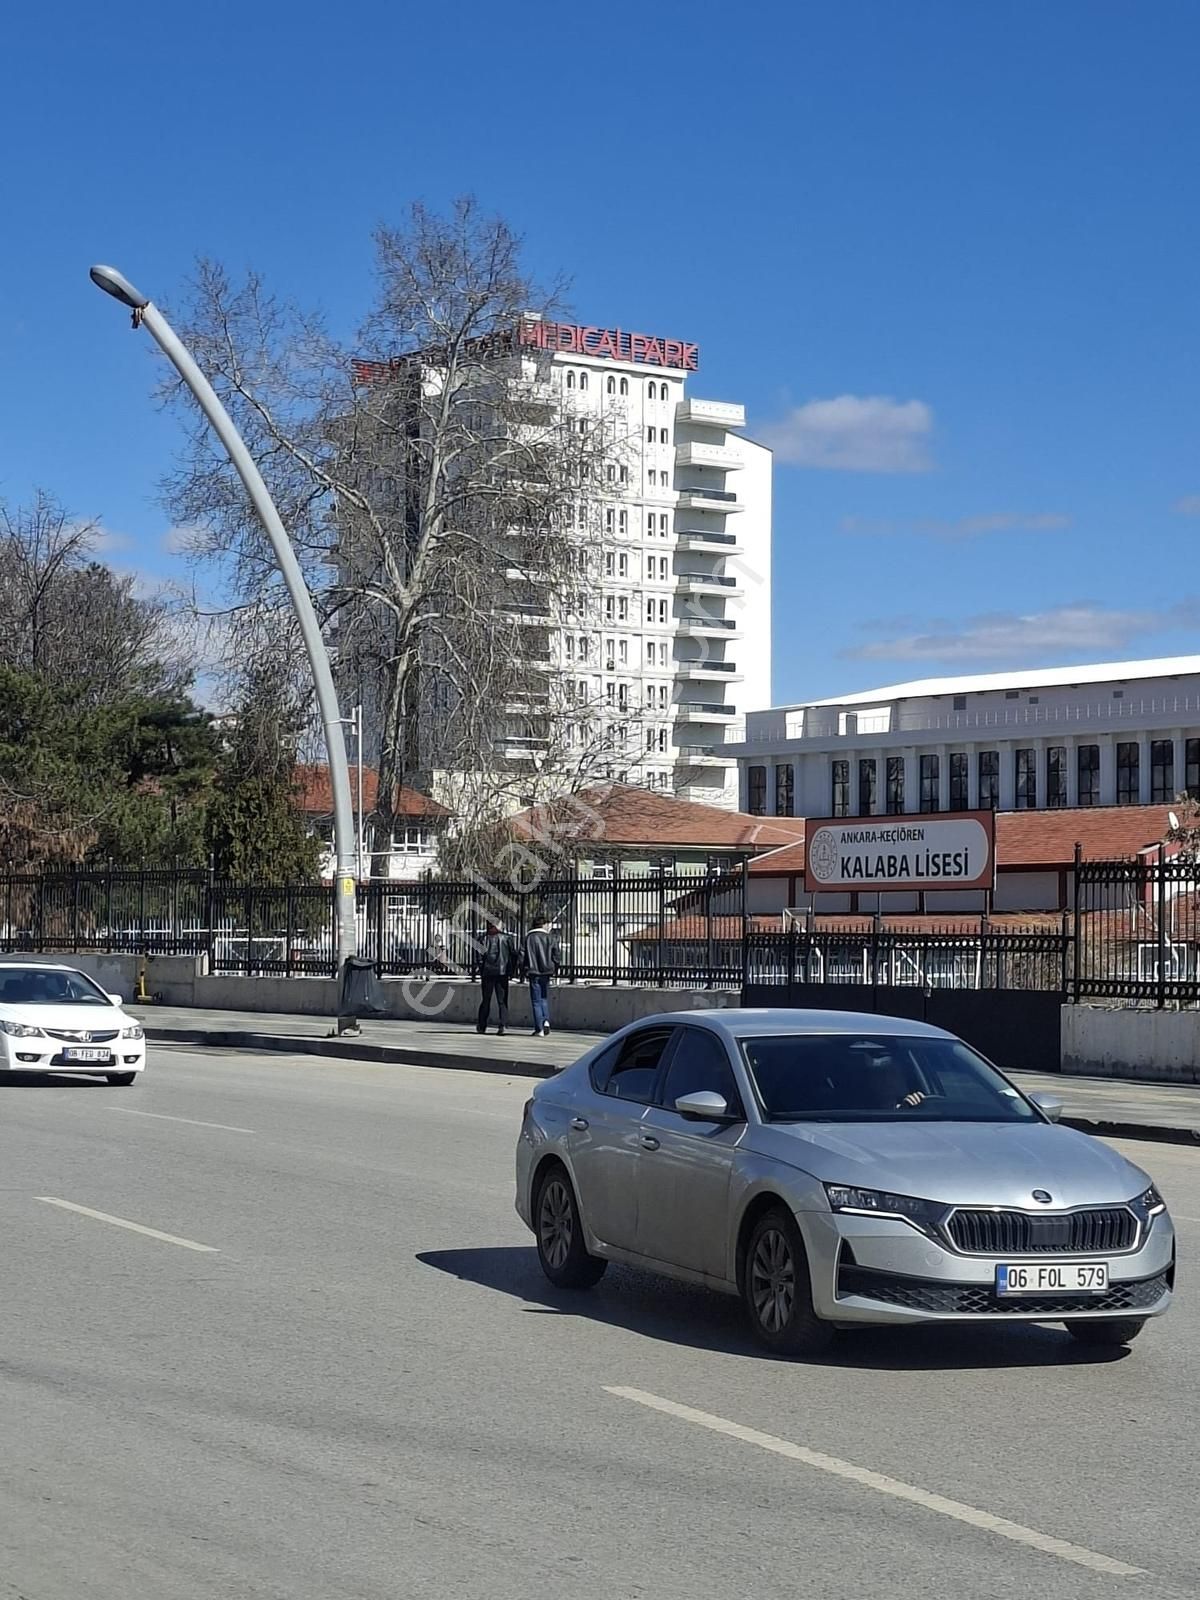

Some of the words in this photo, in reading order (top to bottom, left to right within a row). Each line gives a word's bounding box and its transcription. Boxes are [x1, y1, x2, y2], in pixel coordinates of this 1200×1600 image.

[840, 827, 925, 845] ANKARA-KEÇİÖREN
[840, 854, 910, 878] KALABA
[915, 847, 969, 877] LİSESİ
[1008, 1268, 1028, 1288] 06
[1038, 1268, 1066, 1288] FOL
[1077, 1267, 1105, 1287] 579
